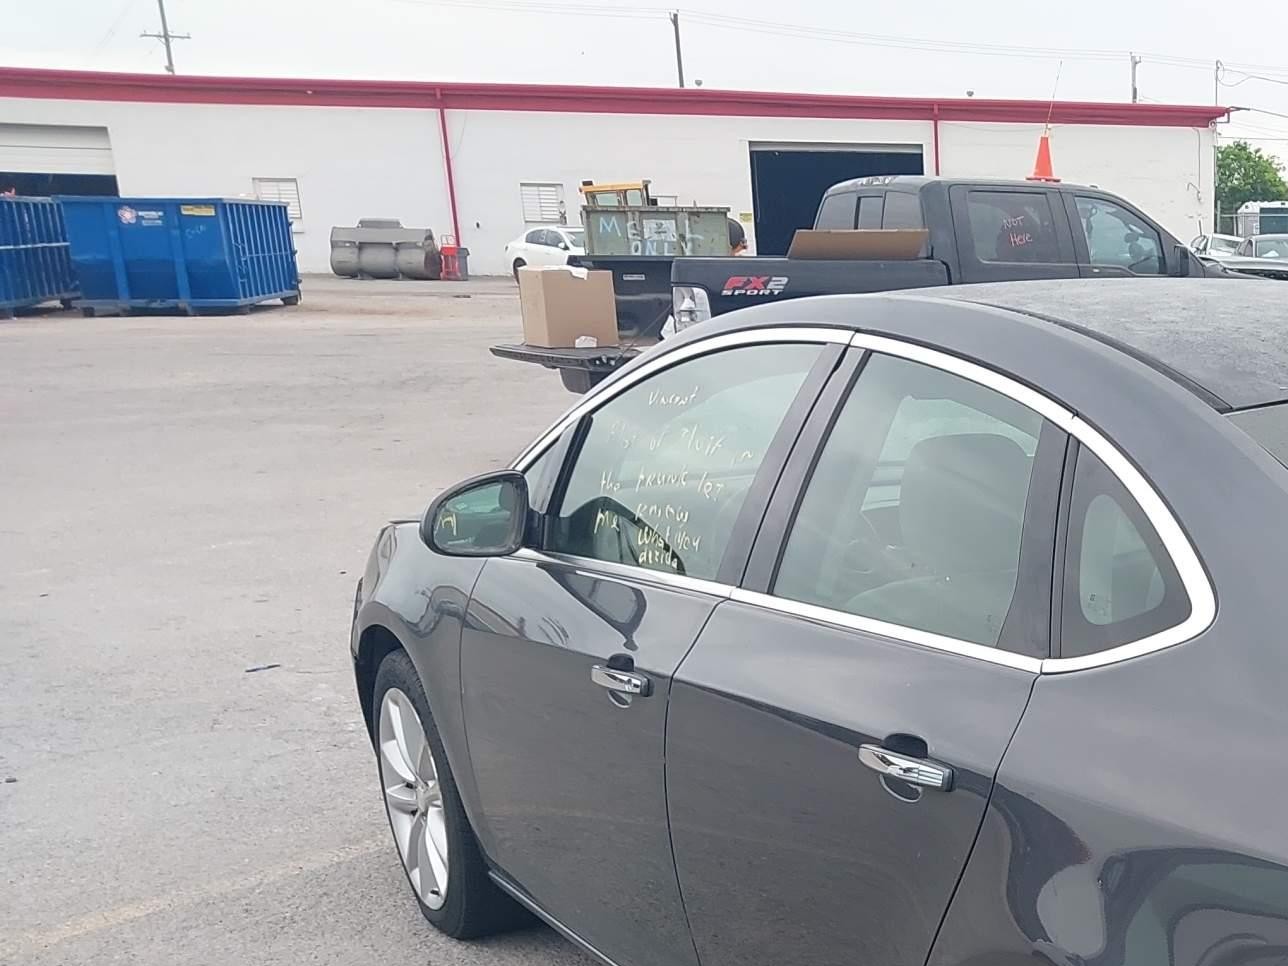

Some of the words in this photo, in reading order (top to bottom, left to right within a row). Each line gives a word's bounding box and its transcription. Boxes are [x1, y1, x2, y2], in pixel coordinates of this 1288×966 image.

[631, 240, 694, 256] ONLY
[723, 275, 789, 290] FX2
[721, 289, 784, 297] SPORT
